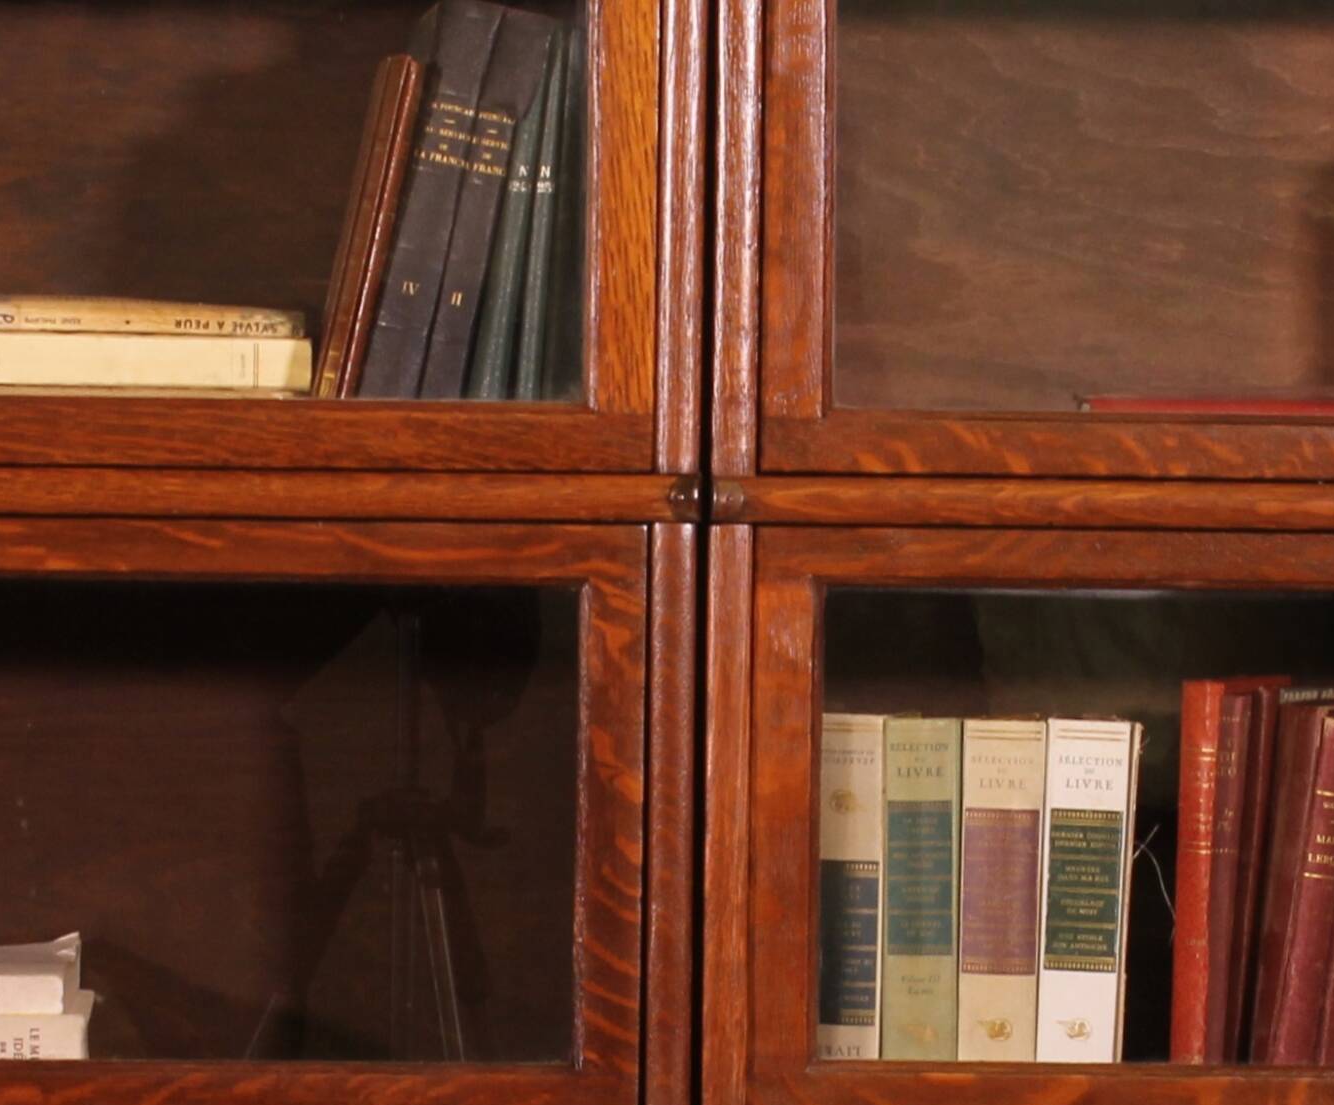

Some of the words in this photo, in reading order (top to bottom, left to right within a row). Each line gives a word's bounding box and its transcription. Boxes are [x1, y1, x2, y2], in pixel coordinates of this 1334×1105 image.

[451, 292, 463, 307] II
[175, 319, 210, 330] PEUR
[897, 765, 944, 779] LIVRE
[978, 777, 1027, 790] LIVRE
[1065, 777, 1115, 791] LIVRE
[29, 1028, 40, 1041] LE
